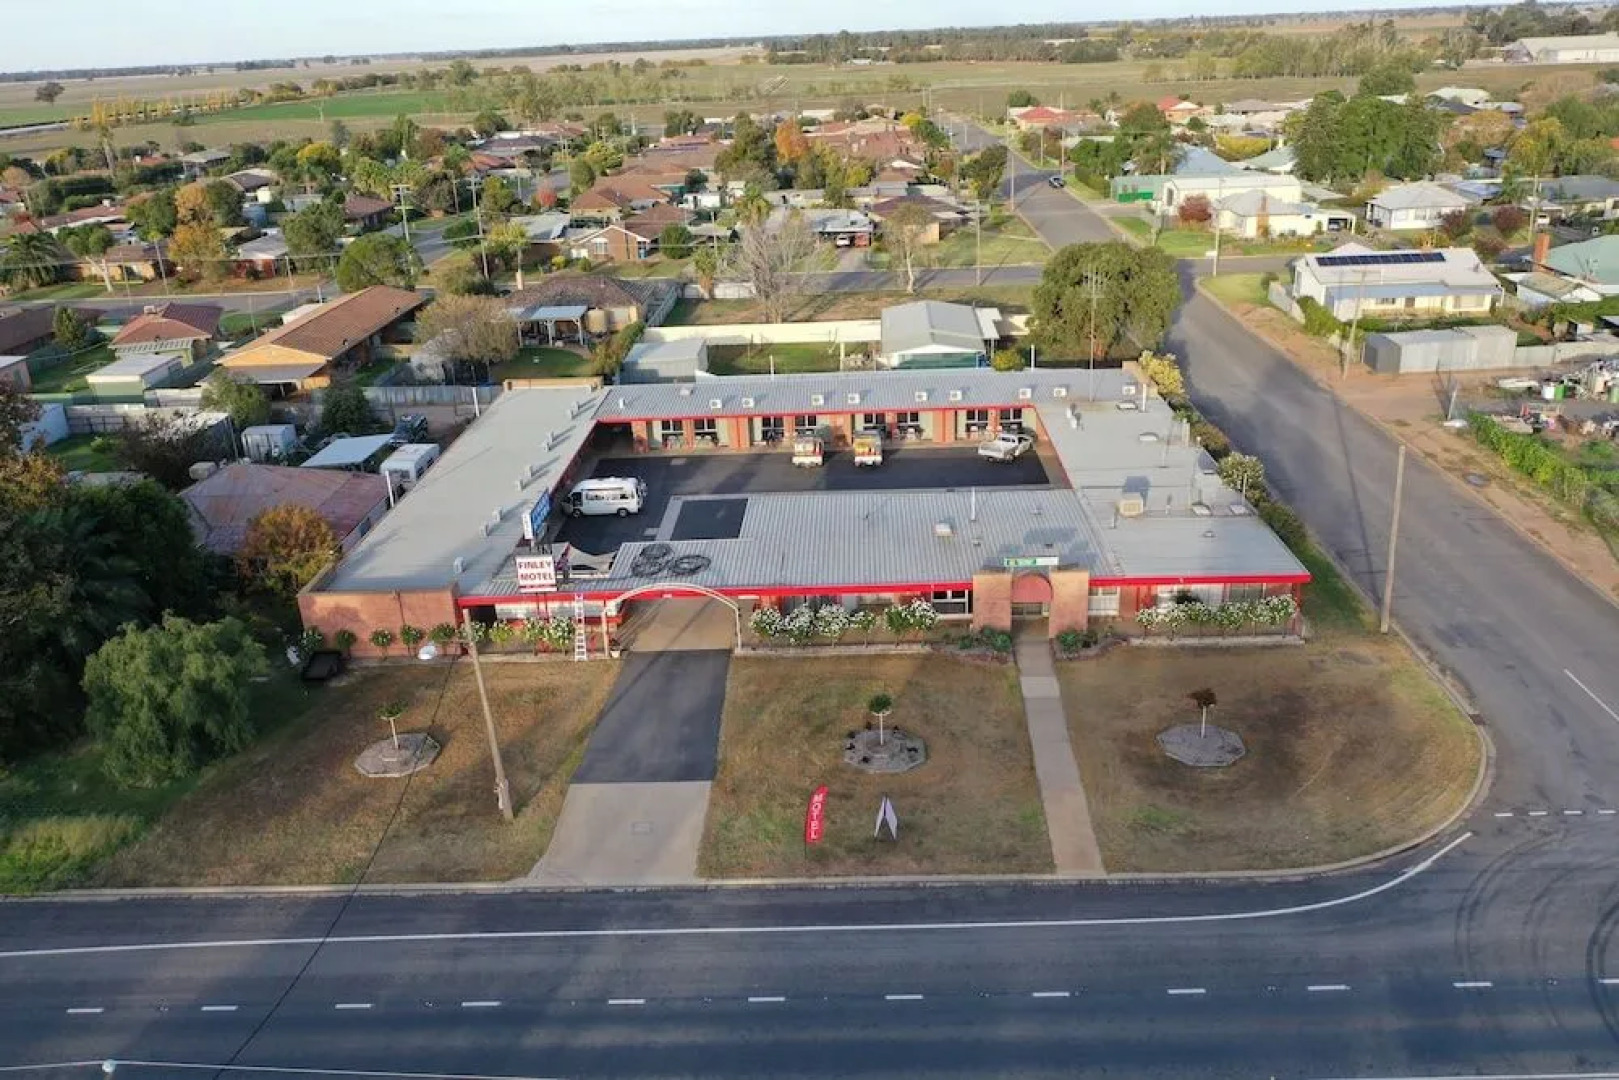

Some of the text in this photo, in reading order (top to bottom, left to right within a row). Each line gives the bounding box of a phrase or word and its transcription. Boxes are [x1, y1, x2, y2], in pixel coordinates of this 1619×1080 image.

[518, 561, 552, 569] FINLEY
[520, 572, 554, 580] MOTEL
[810, 794, 823, 840] MOTEL
